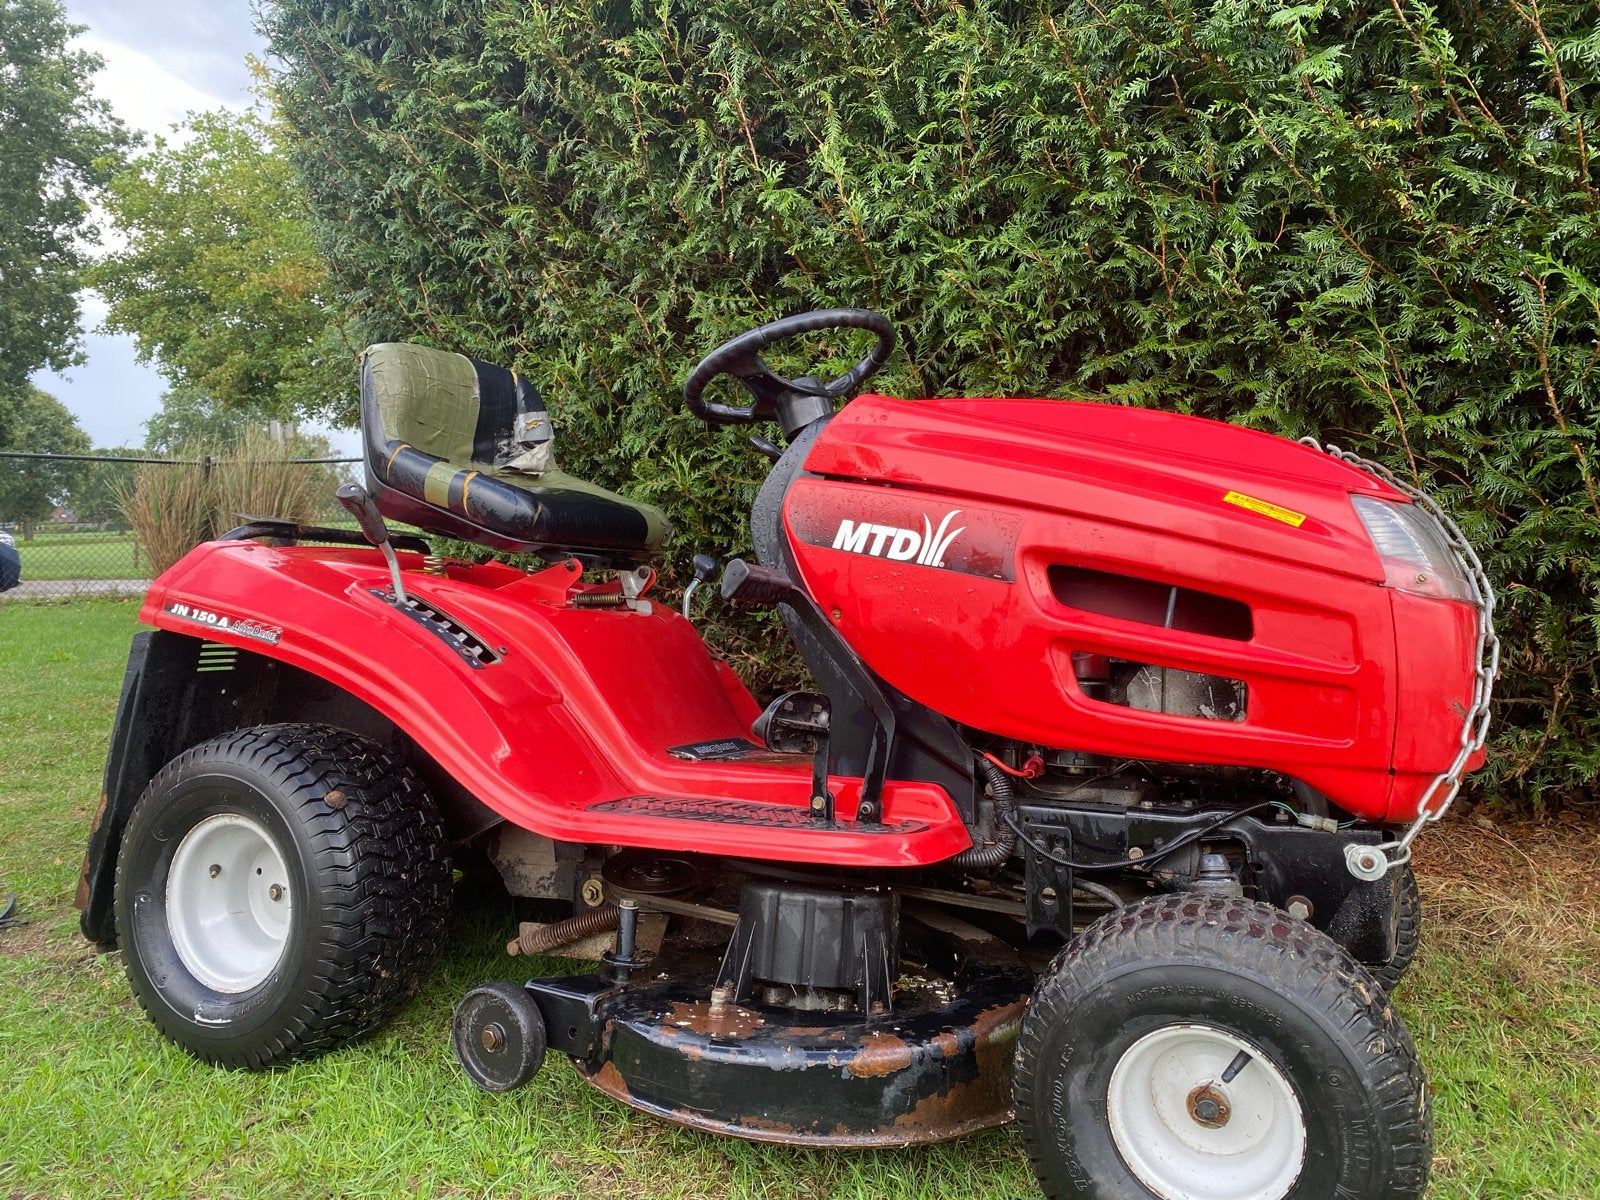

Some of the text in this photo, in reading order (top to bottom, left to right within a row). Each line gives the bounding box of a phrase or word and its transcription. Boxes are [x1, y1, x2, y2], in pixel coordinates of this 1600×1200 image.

[831, 519, 921, 561] MTD
[170, 603, 190, 617] JN
[191, 609, 216, 624] 150
[217, 617, 229, 628] A
[1127, 989, 1148, 1004] NOT
[1151, 985, 1175, 996] FOR
